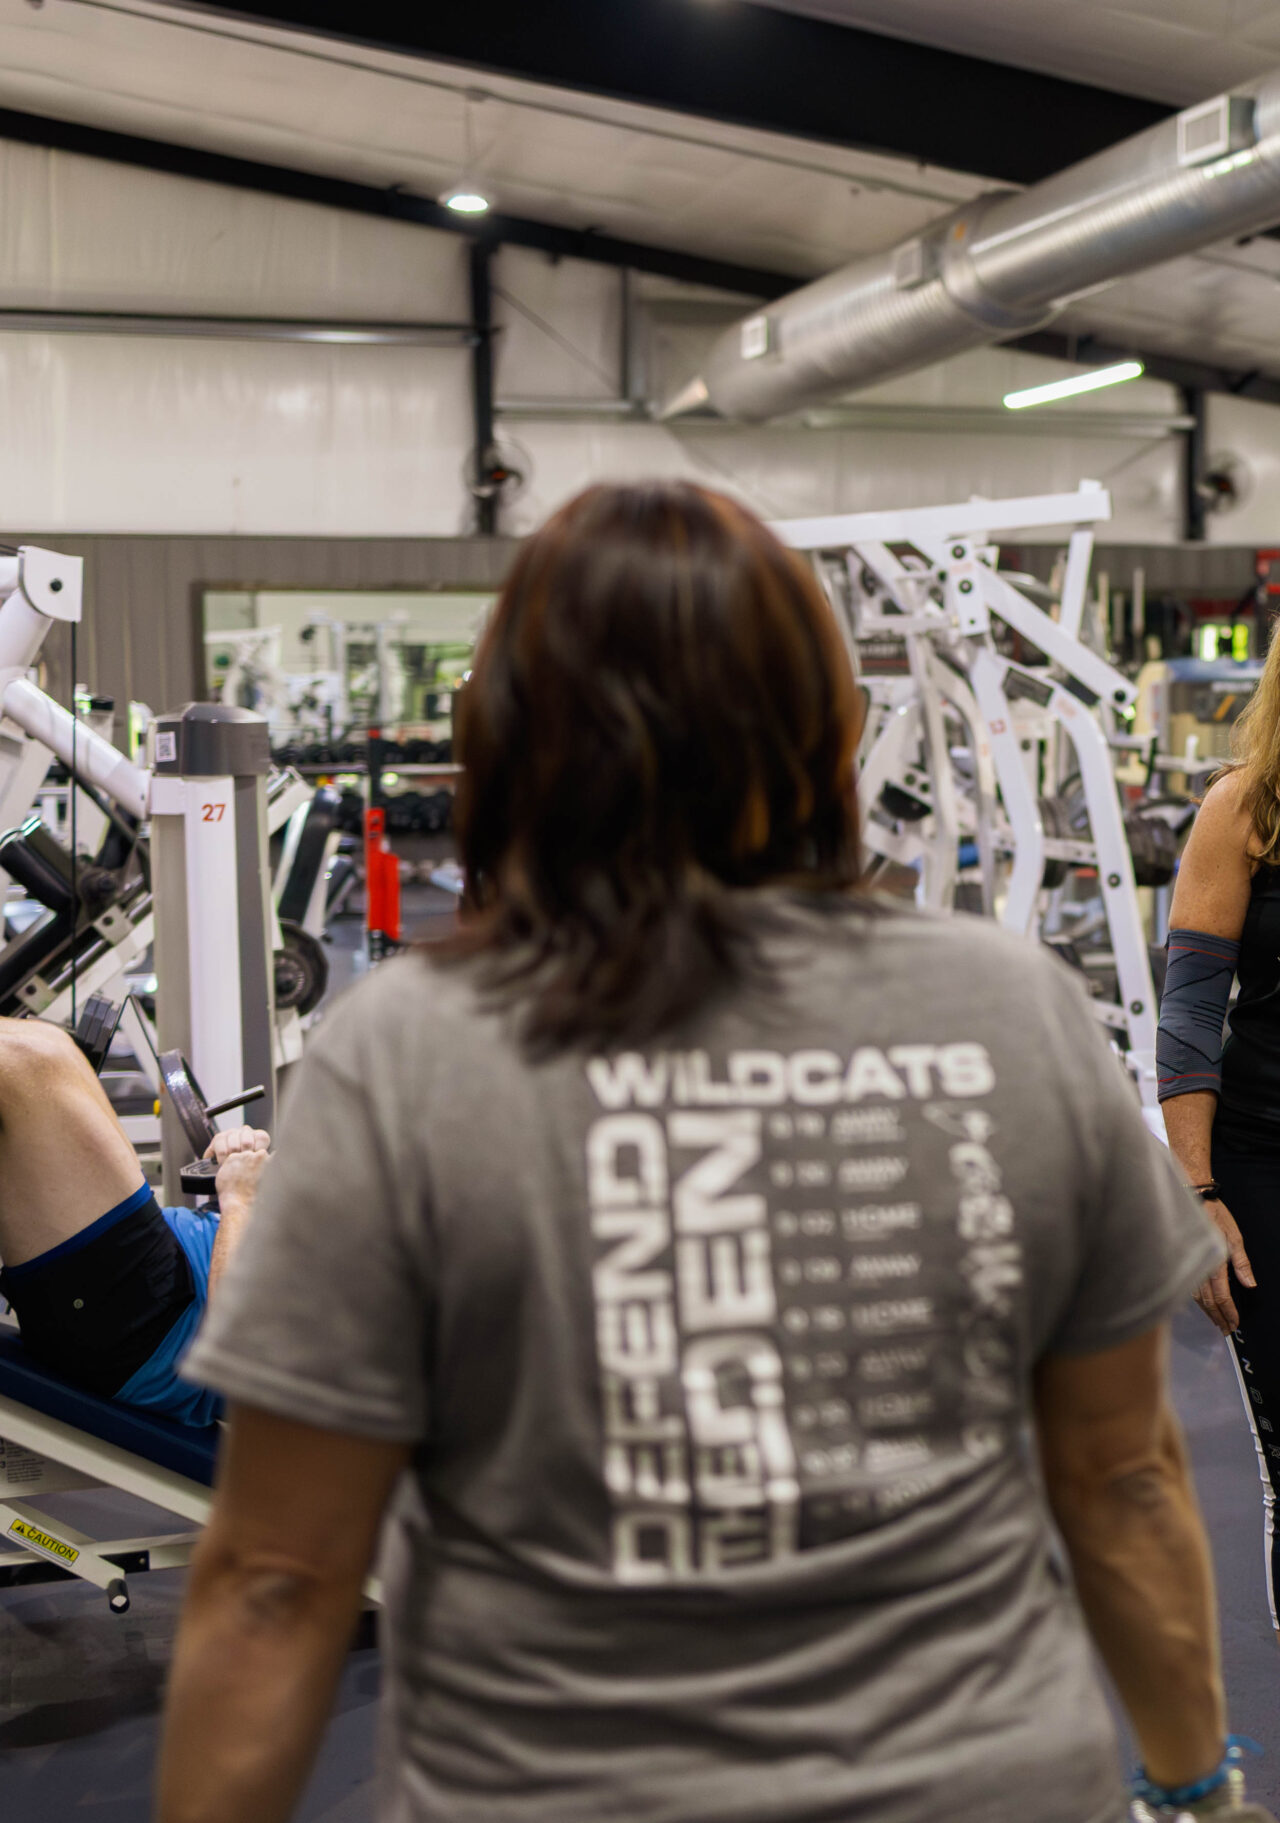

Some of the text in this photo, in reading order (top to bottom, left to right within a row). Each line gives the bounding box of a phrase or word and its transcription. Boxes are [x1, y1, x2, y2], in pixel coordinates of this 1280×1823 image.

[201, 803, 226, 822] 27
[587, 1042, 996, 1108] WILDCATS
[586, 1112, 694, 1583] DEFEND
[27, 1529, 75, 1559] CAUTION
